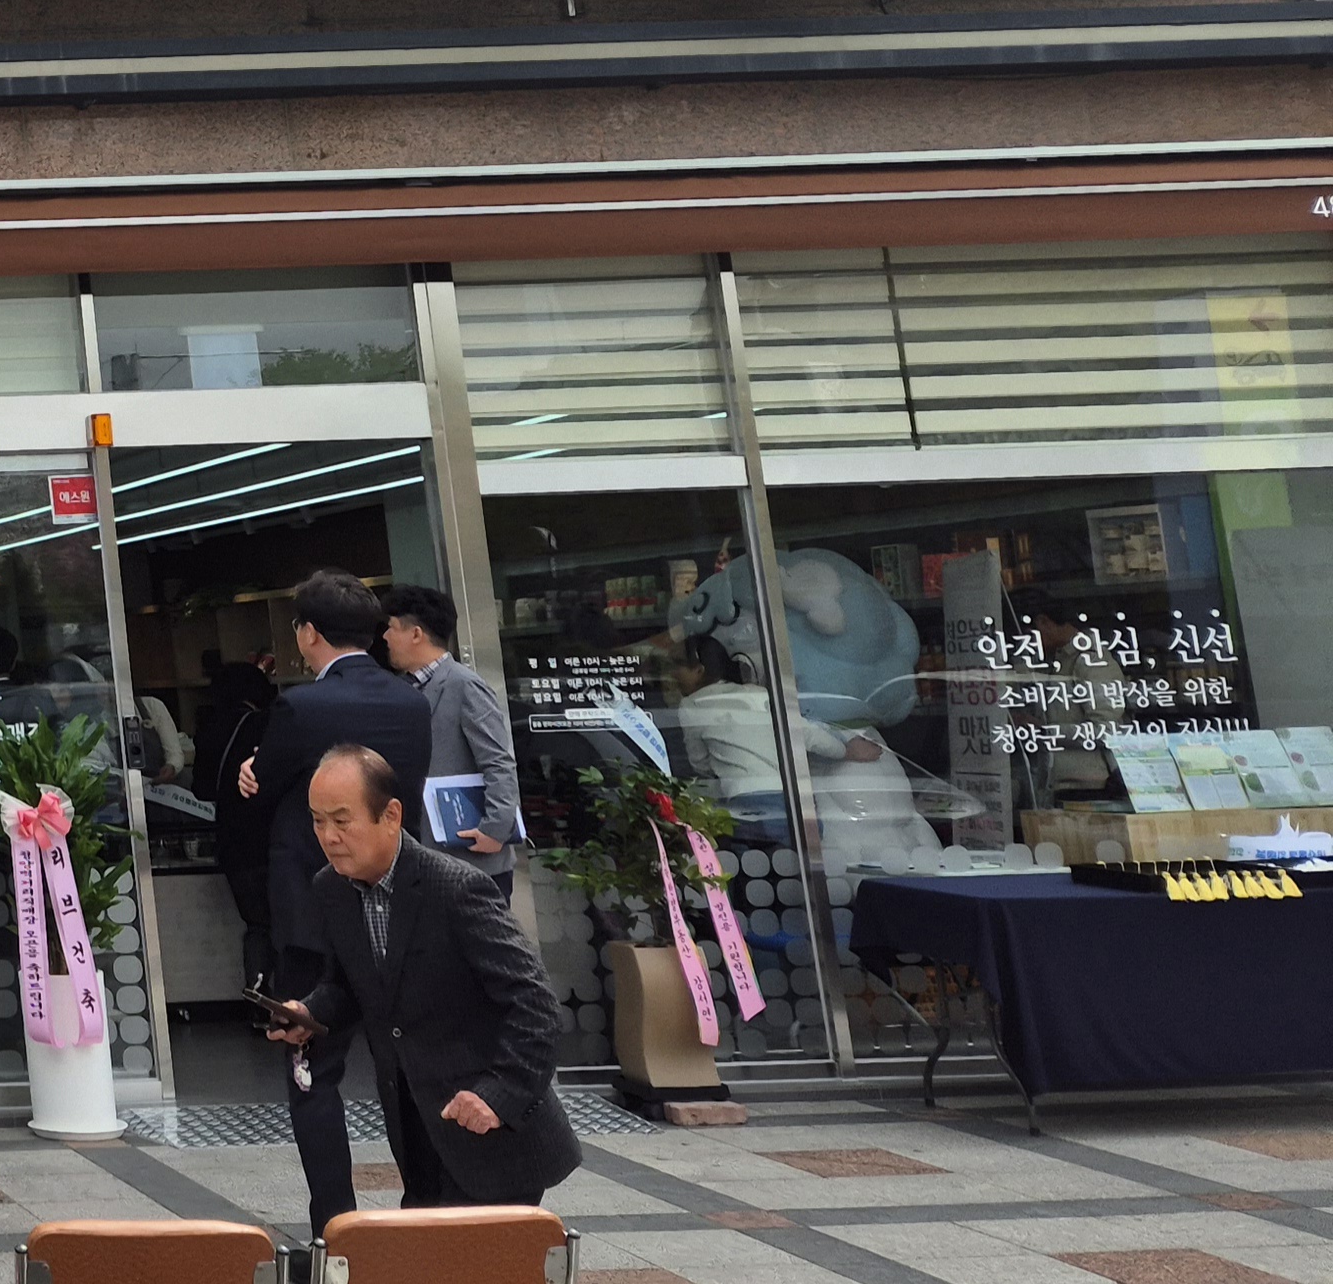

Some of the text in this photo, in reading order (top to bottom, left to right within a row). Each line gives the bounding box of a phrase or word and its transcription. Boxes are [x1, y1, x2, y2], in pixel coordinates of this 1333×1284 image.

[59, 490, 90, 504] 에스원
[977, 628, 1062, 673] 안전,
[1072, 624, 1157, 670] 안심,
[1168, 622, 1239, 665] 신선
[582, 657, 600, 666] 10시
[531, 678, 560, 690] 토요일
[585, 677, 603, 688] 10시
[629, 676, 643, 686] 6시
[998, 679, 1096, 712] 소비자의
[1102, 678, 1177, 709] 밥상을
[1183, 676, 1234, 707] 위한
[533, 692, 562, 704] 일요일
[631, 690, 645, 701] 6시
[992, 724, 1065, 755] 청양군
[727, 941, 752, 992] 기원합니다
